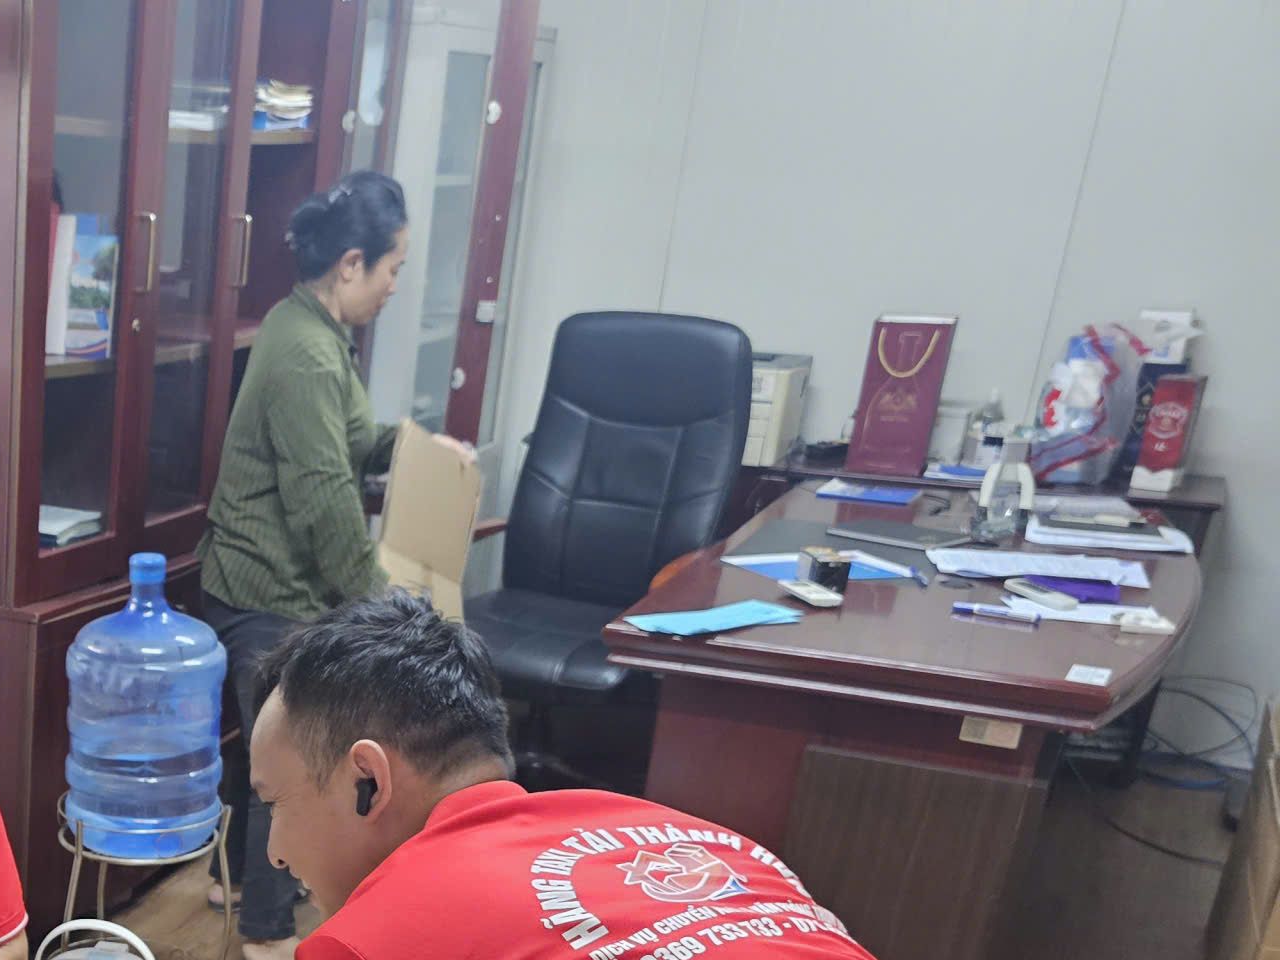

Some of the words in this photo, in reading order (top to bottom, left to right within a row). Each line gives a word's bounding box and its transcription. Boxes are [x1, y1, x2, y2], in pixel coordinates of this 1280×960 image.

[615, 823, 741, 852] THÀNH
[530, 848, 585, 876] TAXI
[531, 879, 609, 950] HÃNG
[627, 927, 660, 946] VỤ
[696, 923, 749, 945] 733
[737, 917, 784, 937] 733
